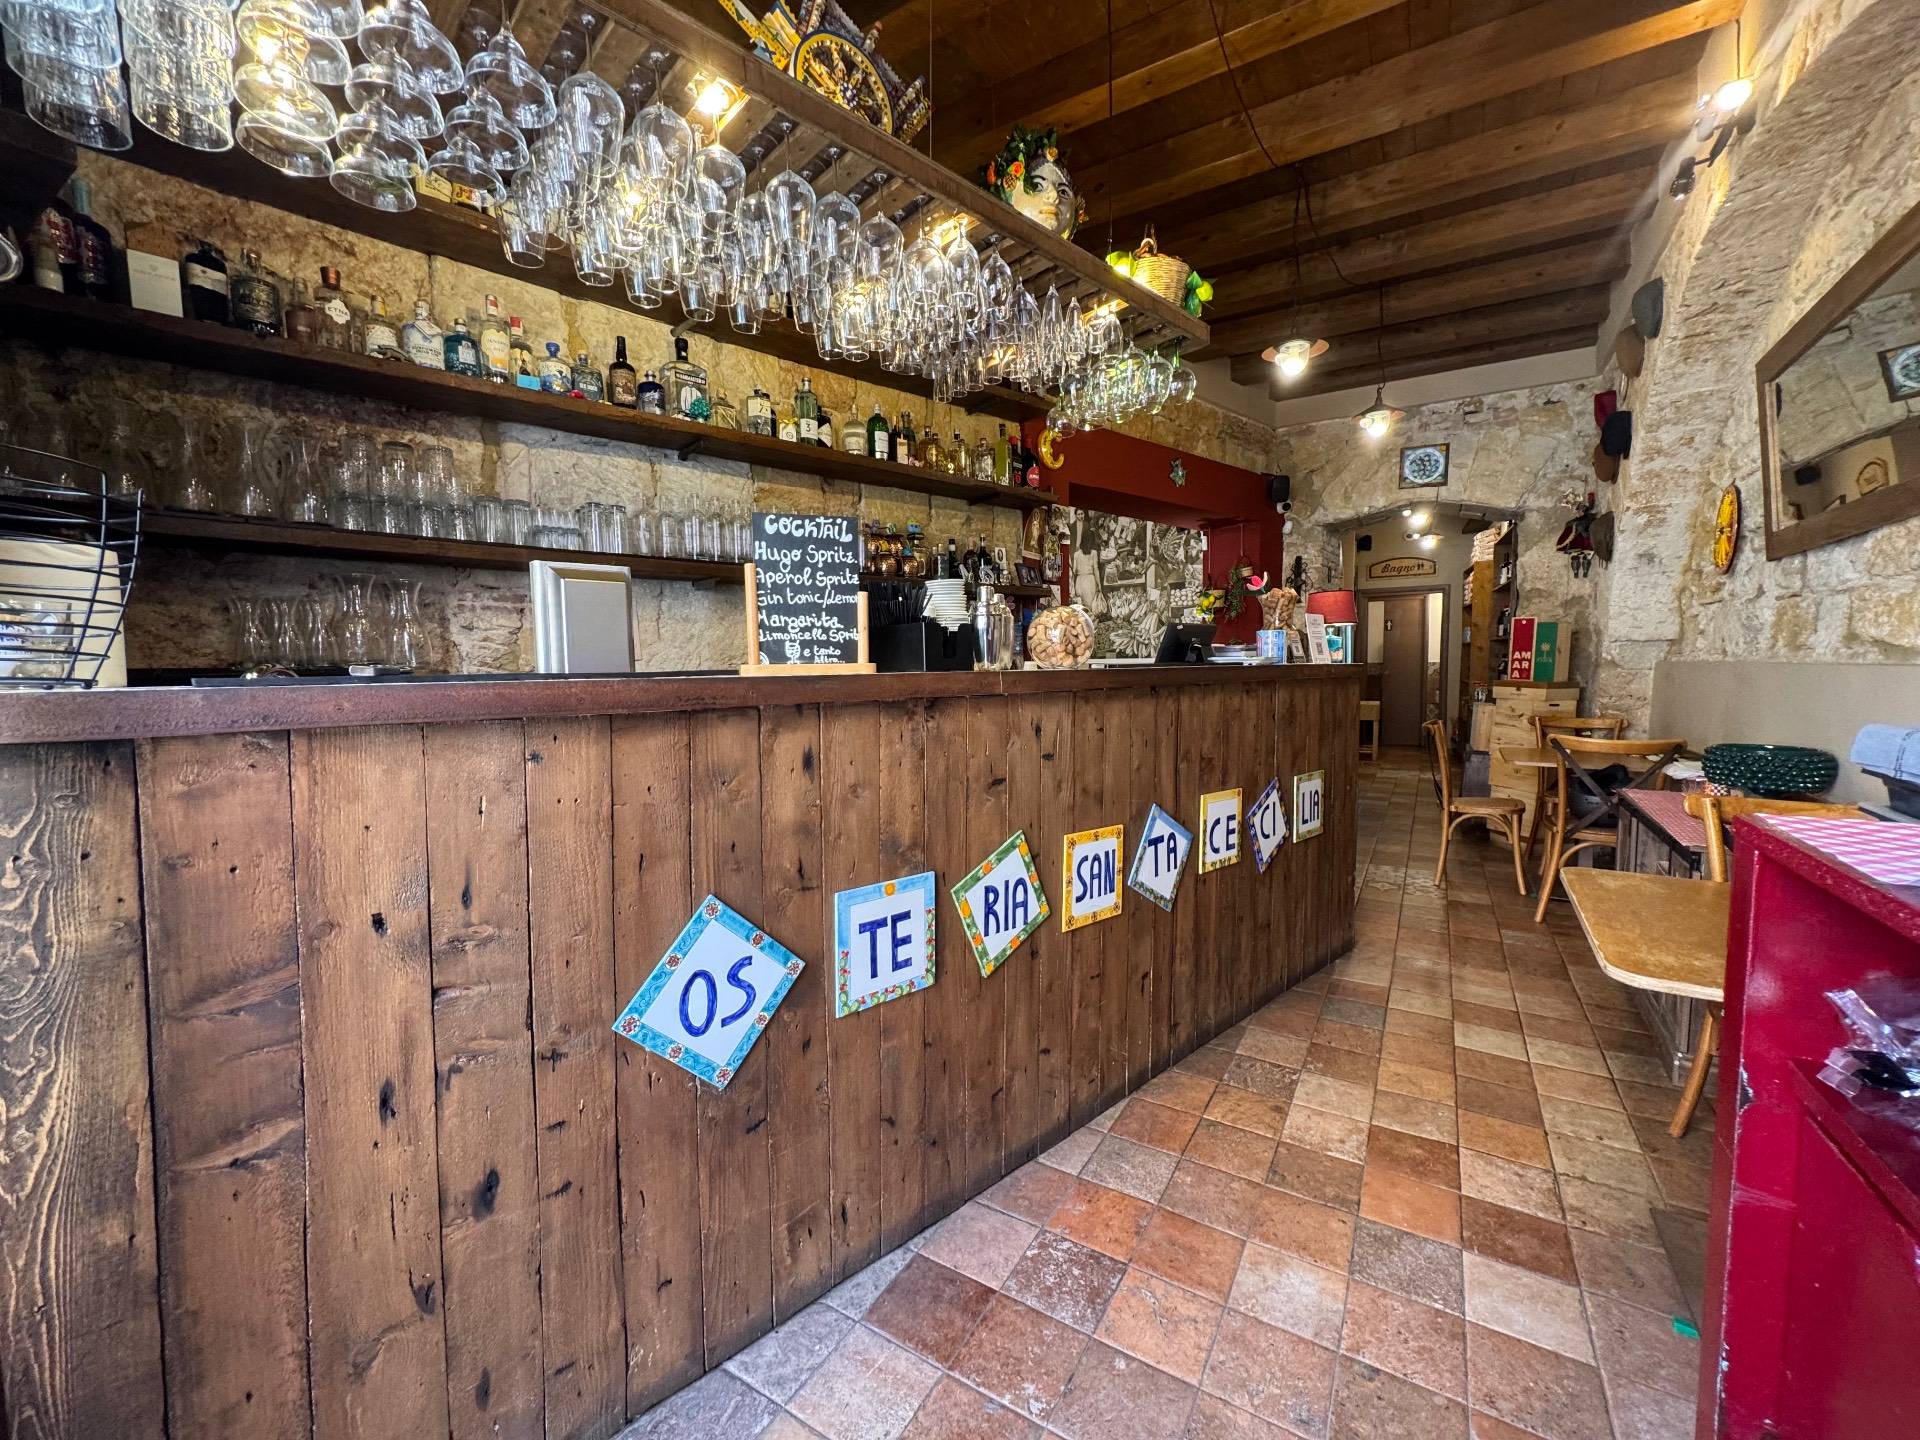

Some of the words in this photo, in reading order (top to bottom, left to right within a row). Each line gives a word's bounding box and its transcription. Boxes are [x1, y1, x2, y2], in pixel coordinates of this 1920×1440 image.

[754, 540, 802, 573] Hugo
[1381, 563, 1416, 574] Bagno
[756, 567, 812, 588] Aperol
[815, 568, 860, 590] Spritz
[757, 590, 784, 606] Gin
[758, 609, 844, 633] Margarita
[759, 628, 827, 642] Limoncello
[803, 648, 812, 656] e
[813, 645, 841, 655] tanto
[1513, 651, 1531, 660] AM
[1512, 660, 1529, 669] AR
[1511, 670, 1520, 679] A
[680, 956, 757, 1038] OS
[859, 910, 912, 980] TE
[983, 877, 1028, 938] RIA
[1075, 849, 1116, 904] SAN
[1147, 831, 1178, 877] TA
[1209, 813, 1237, 854] CE
[1260, 802, 1276, 840] CI
[1301, 788, 1321, 826] LIA
